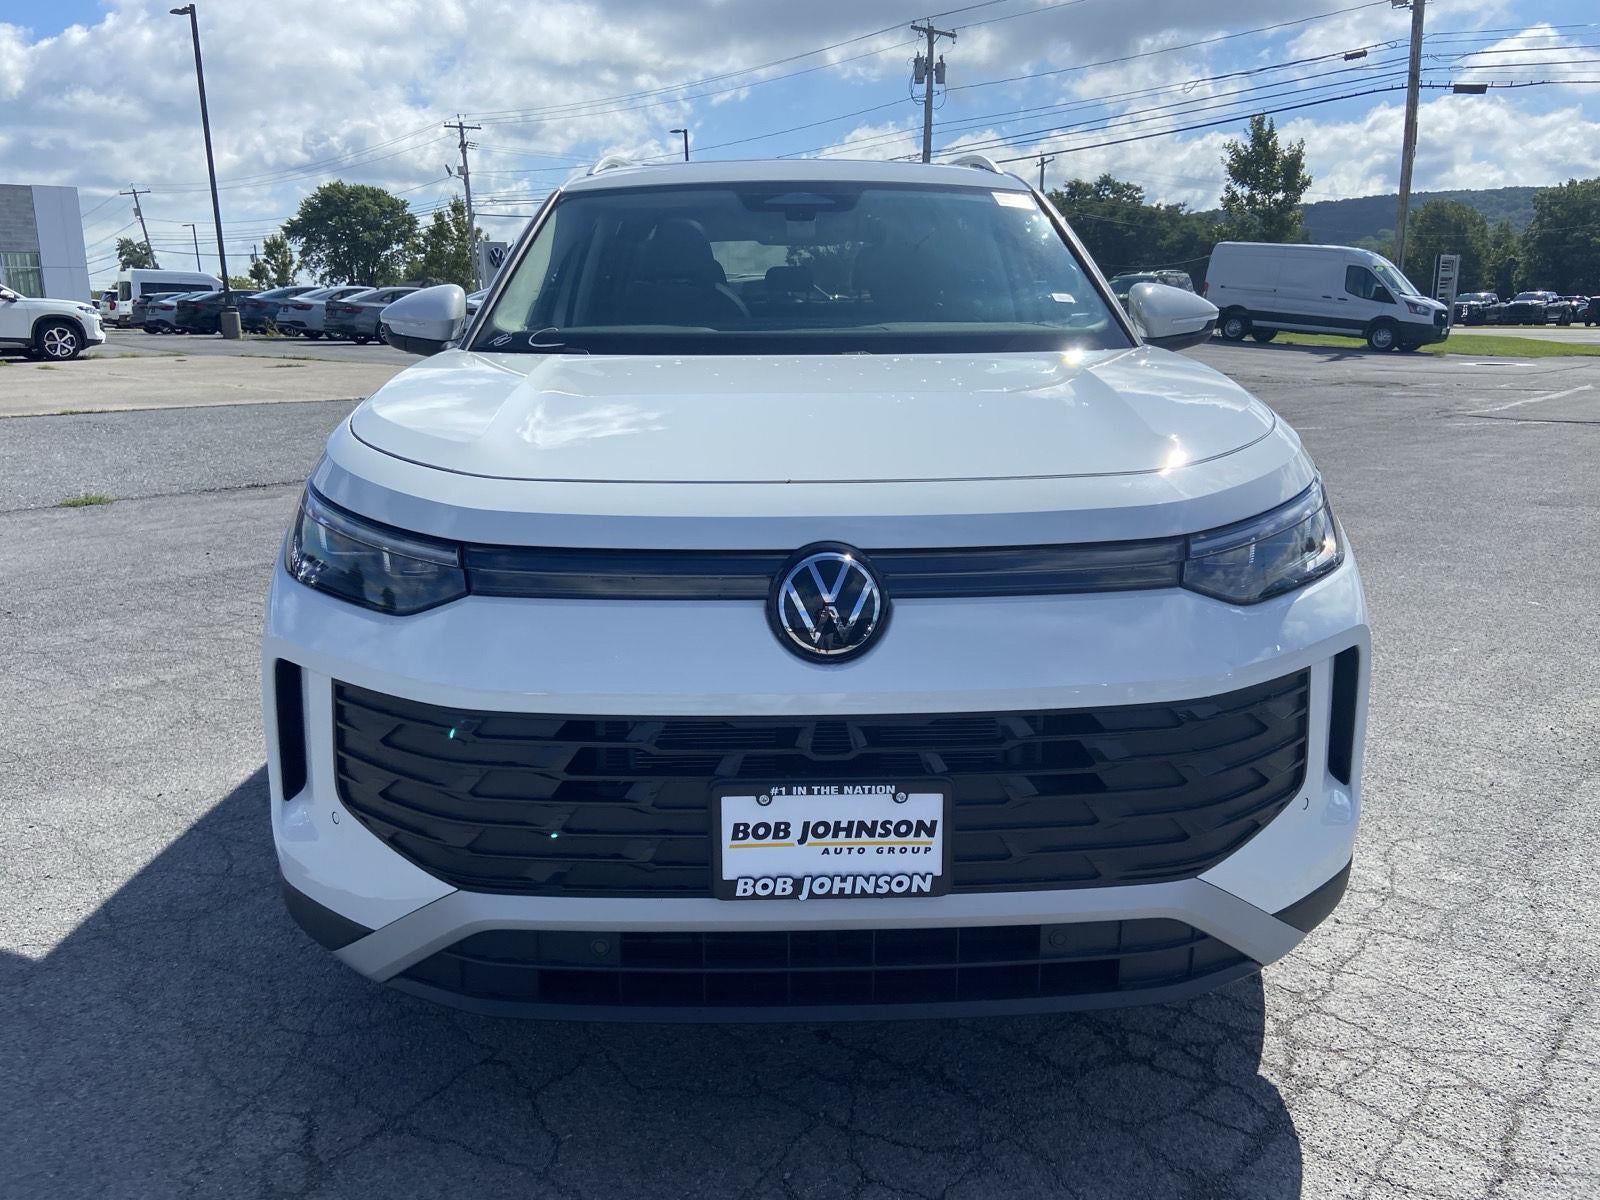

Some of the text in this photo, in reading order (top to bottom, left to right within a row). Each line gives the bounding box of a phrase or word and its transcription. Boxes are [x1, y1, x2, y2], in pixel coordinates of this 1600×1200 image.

[770, 785, 896, 796] #1 IN THE NATION
[731, 819, 938, 845] BOB JOHNSON
[821, 847, 932, 856] AUTO GROUP
[735, 875, 933, 901] BOB JOHNSON
